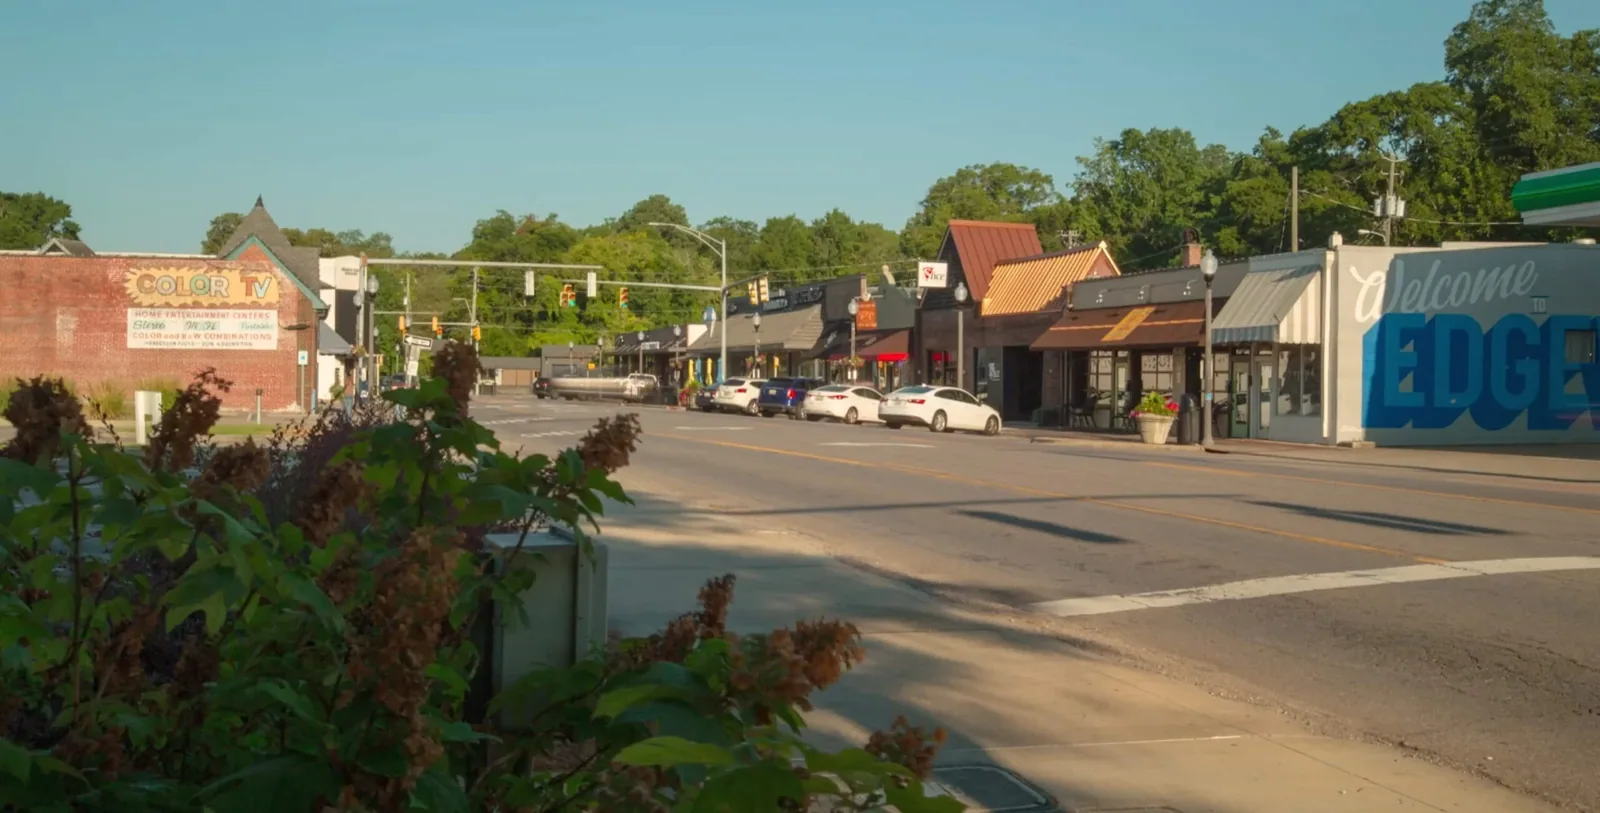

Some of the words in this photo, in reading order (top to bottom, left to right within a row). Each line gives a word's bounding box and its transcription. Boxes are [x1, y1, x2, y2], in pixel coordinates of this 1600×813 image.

[136, 273, 230, 298] COLOR
[240, 276, 273, 299] TV
[1349, 259, 1539, 323] Welcome
[1532, 297, 1546, 312] TO
[134, 311, 162, 319] HOME
[165, 311, 230, 319] ENTERTAINMENT
[232, 311, 271, 319] CENTERS
[132, 320, 166, 330] Stereo
[132, 332, 162, 340] COLOR
[203, 332, 272, 341] COMBINATIONS
[1362, 312, 1600, 430] EDGE
